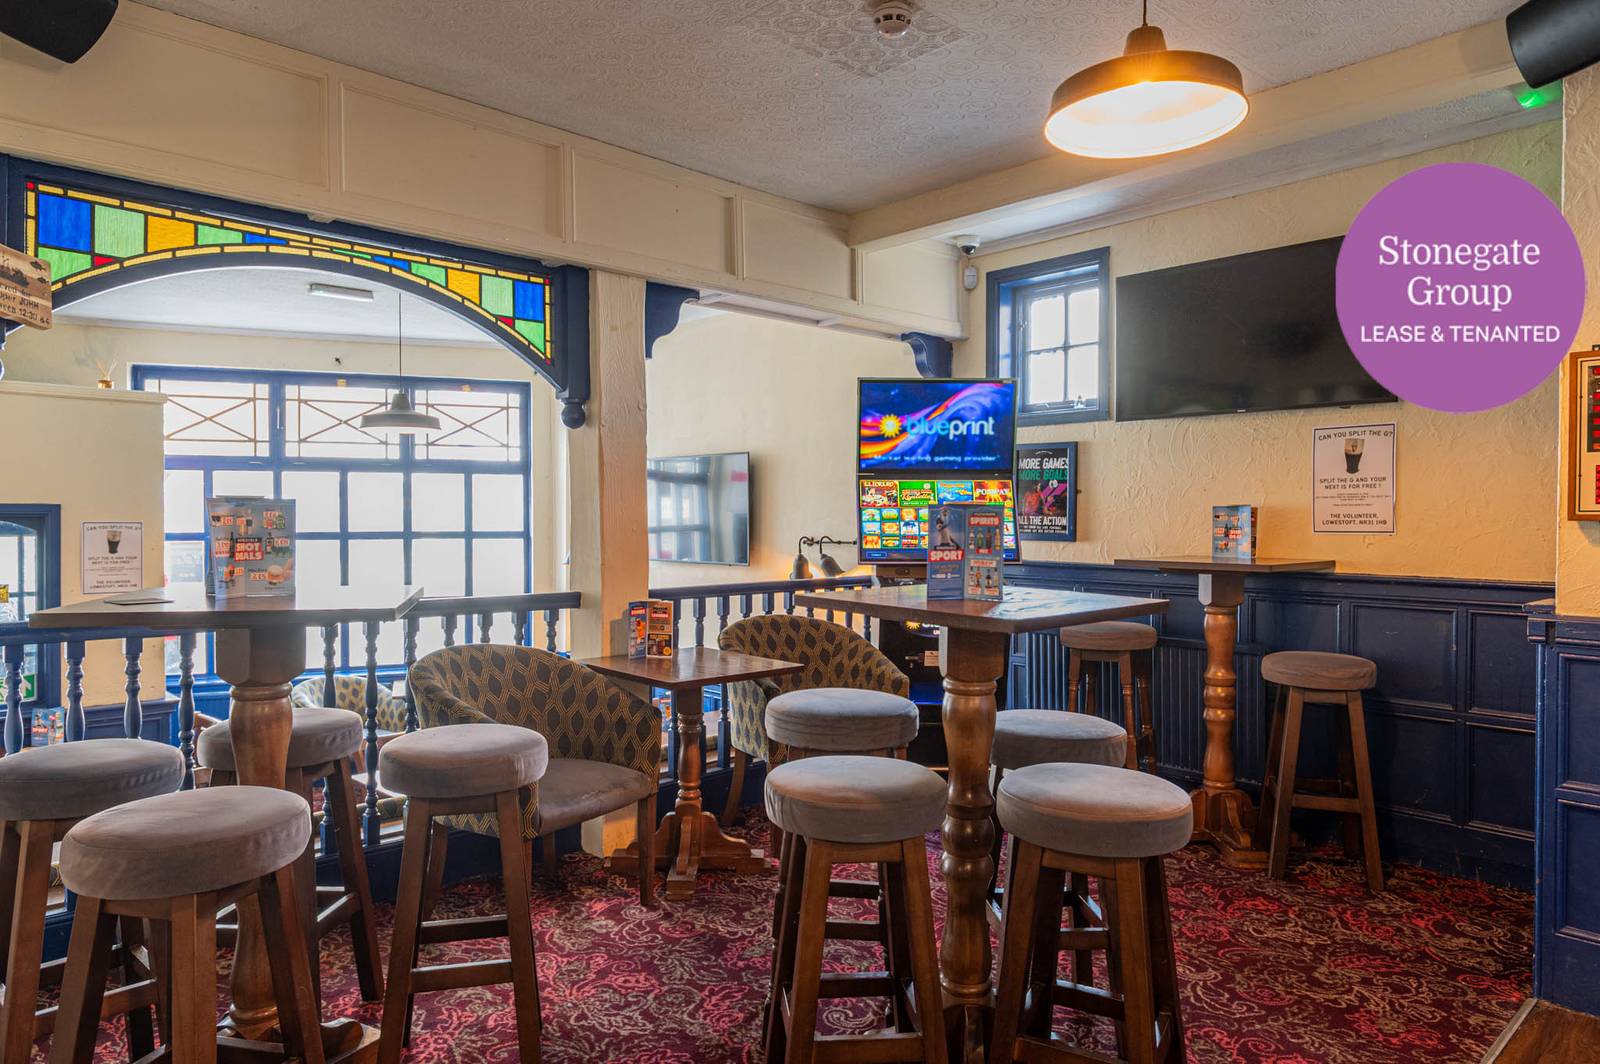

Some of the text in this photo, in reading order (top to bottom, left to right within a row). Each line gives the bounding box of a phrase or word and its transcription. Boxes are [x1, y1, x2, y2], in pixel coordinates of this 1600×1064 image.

[907, 416, 995, 440] blueprint
[1318, 433, 1332, 441] CAN
[1018, 456, 1069, 469] MORE GAMES
[1018, 468, 1068, 480] MORE GOALS
[1029, 516, 1042, 525] THE
[236, 542, 260, 551] SHOT
[930, 550, 963, 561] SPORT
